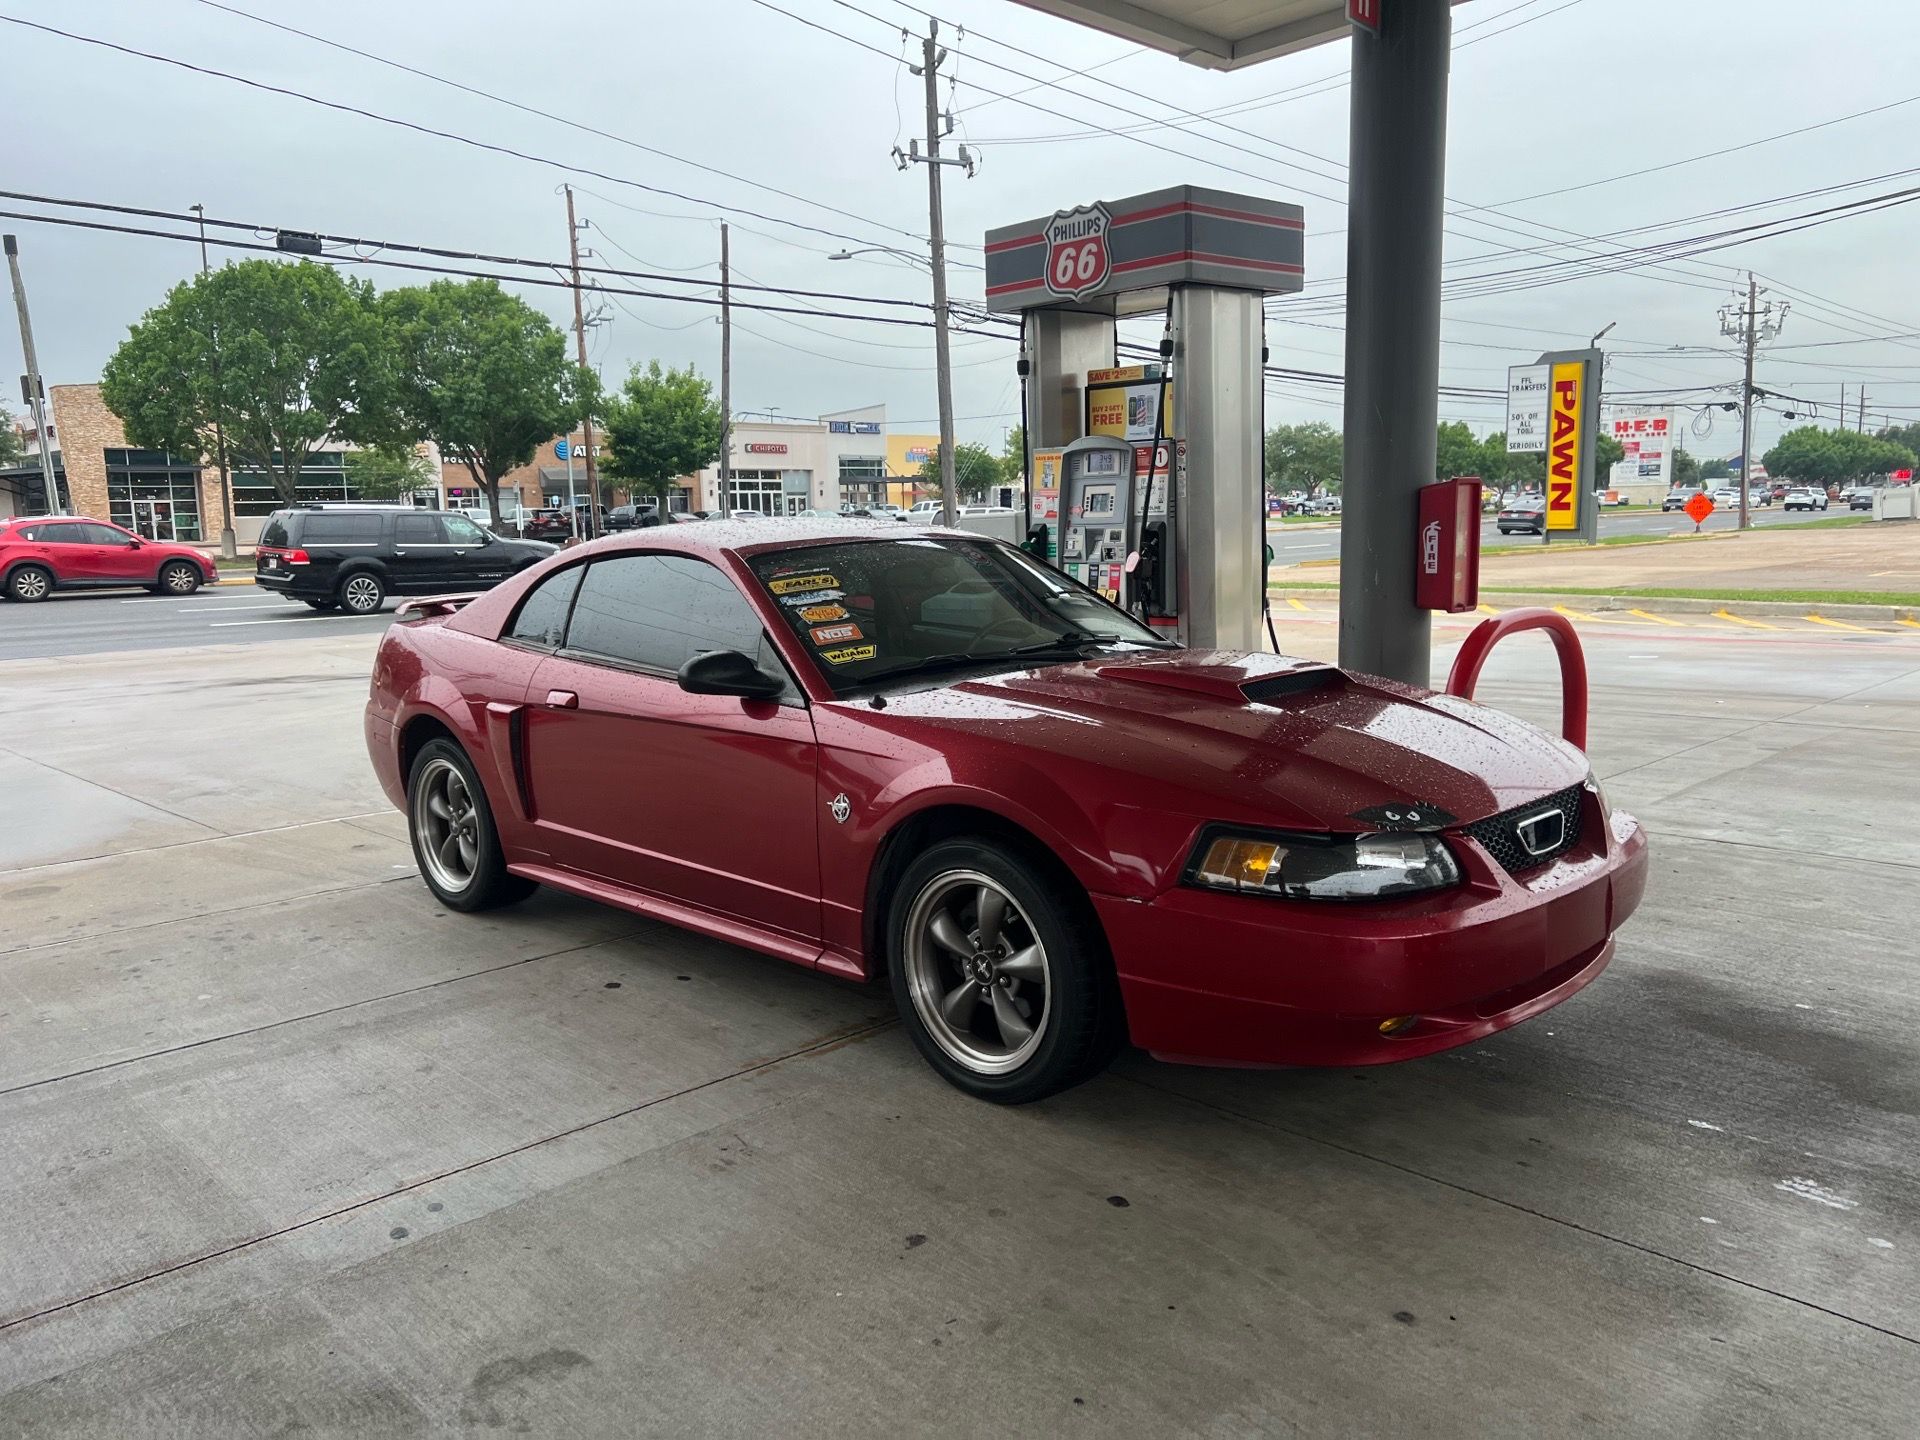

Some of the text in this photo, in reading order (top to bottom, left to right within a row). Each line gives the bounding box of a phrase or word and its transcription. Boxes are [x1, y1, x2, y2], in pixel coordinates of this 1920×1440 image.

[1053, 217, 1101, 242] PHILLIPS
[1056, 243, 1098, 284] 66
[1089, 371, 1111, 382] SAVE
[1511, 383, 1547, 391] TRANSFERS
[1092, 405, 1104, 413] BUY
[1092, 413, 1122, 426] FREE
[1550, 380, 1577, 511] PAWN
[1428, 535, 1437, 570] FIRE
[815, 626, 853, 640] NOS
[830, 648, 871, 660] WEIAND
